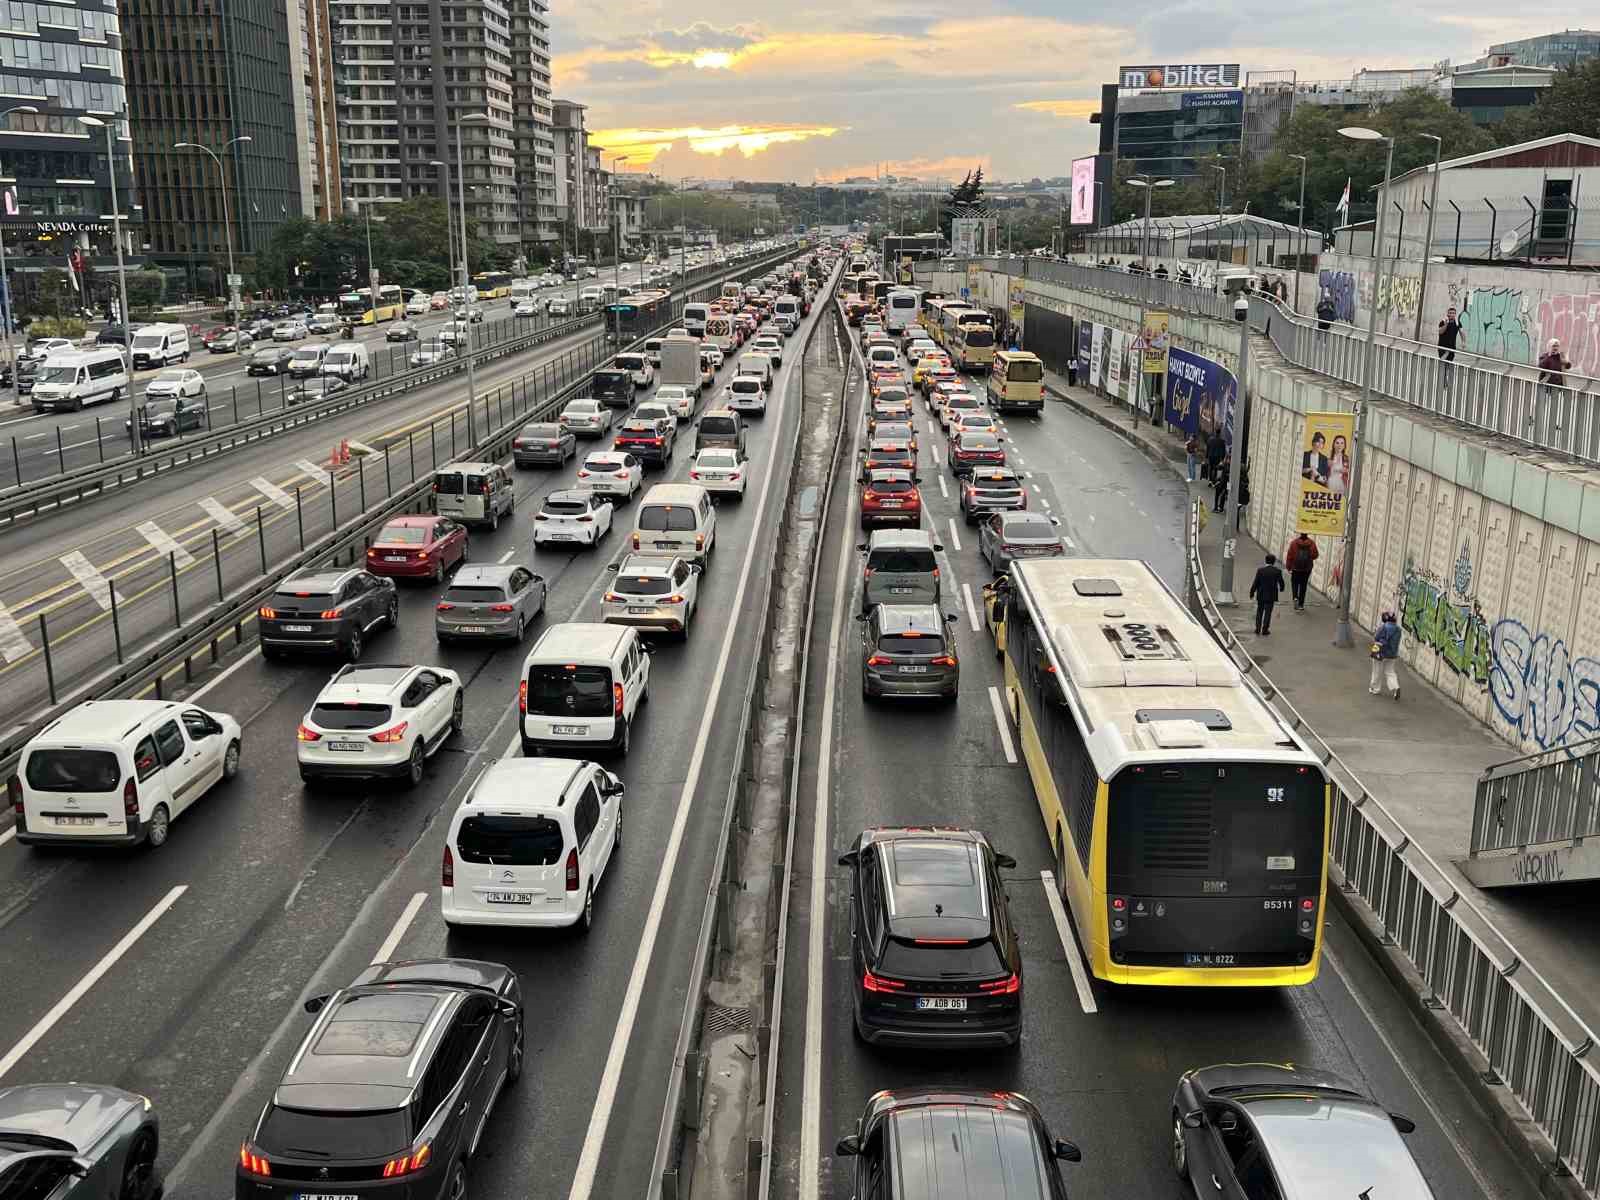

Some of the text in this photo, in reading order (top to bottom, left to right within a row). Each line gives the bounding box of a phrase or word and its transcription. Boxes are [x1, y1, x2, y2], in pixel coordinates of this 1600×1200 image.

[37, 222, 109, 232] NEVADA Coffee
[1303, 490, 1342, 502] TUZLU
[1302, 499, 1342, 511] KAHVE
[1263, 900, 1293, 910] B5311
